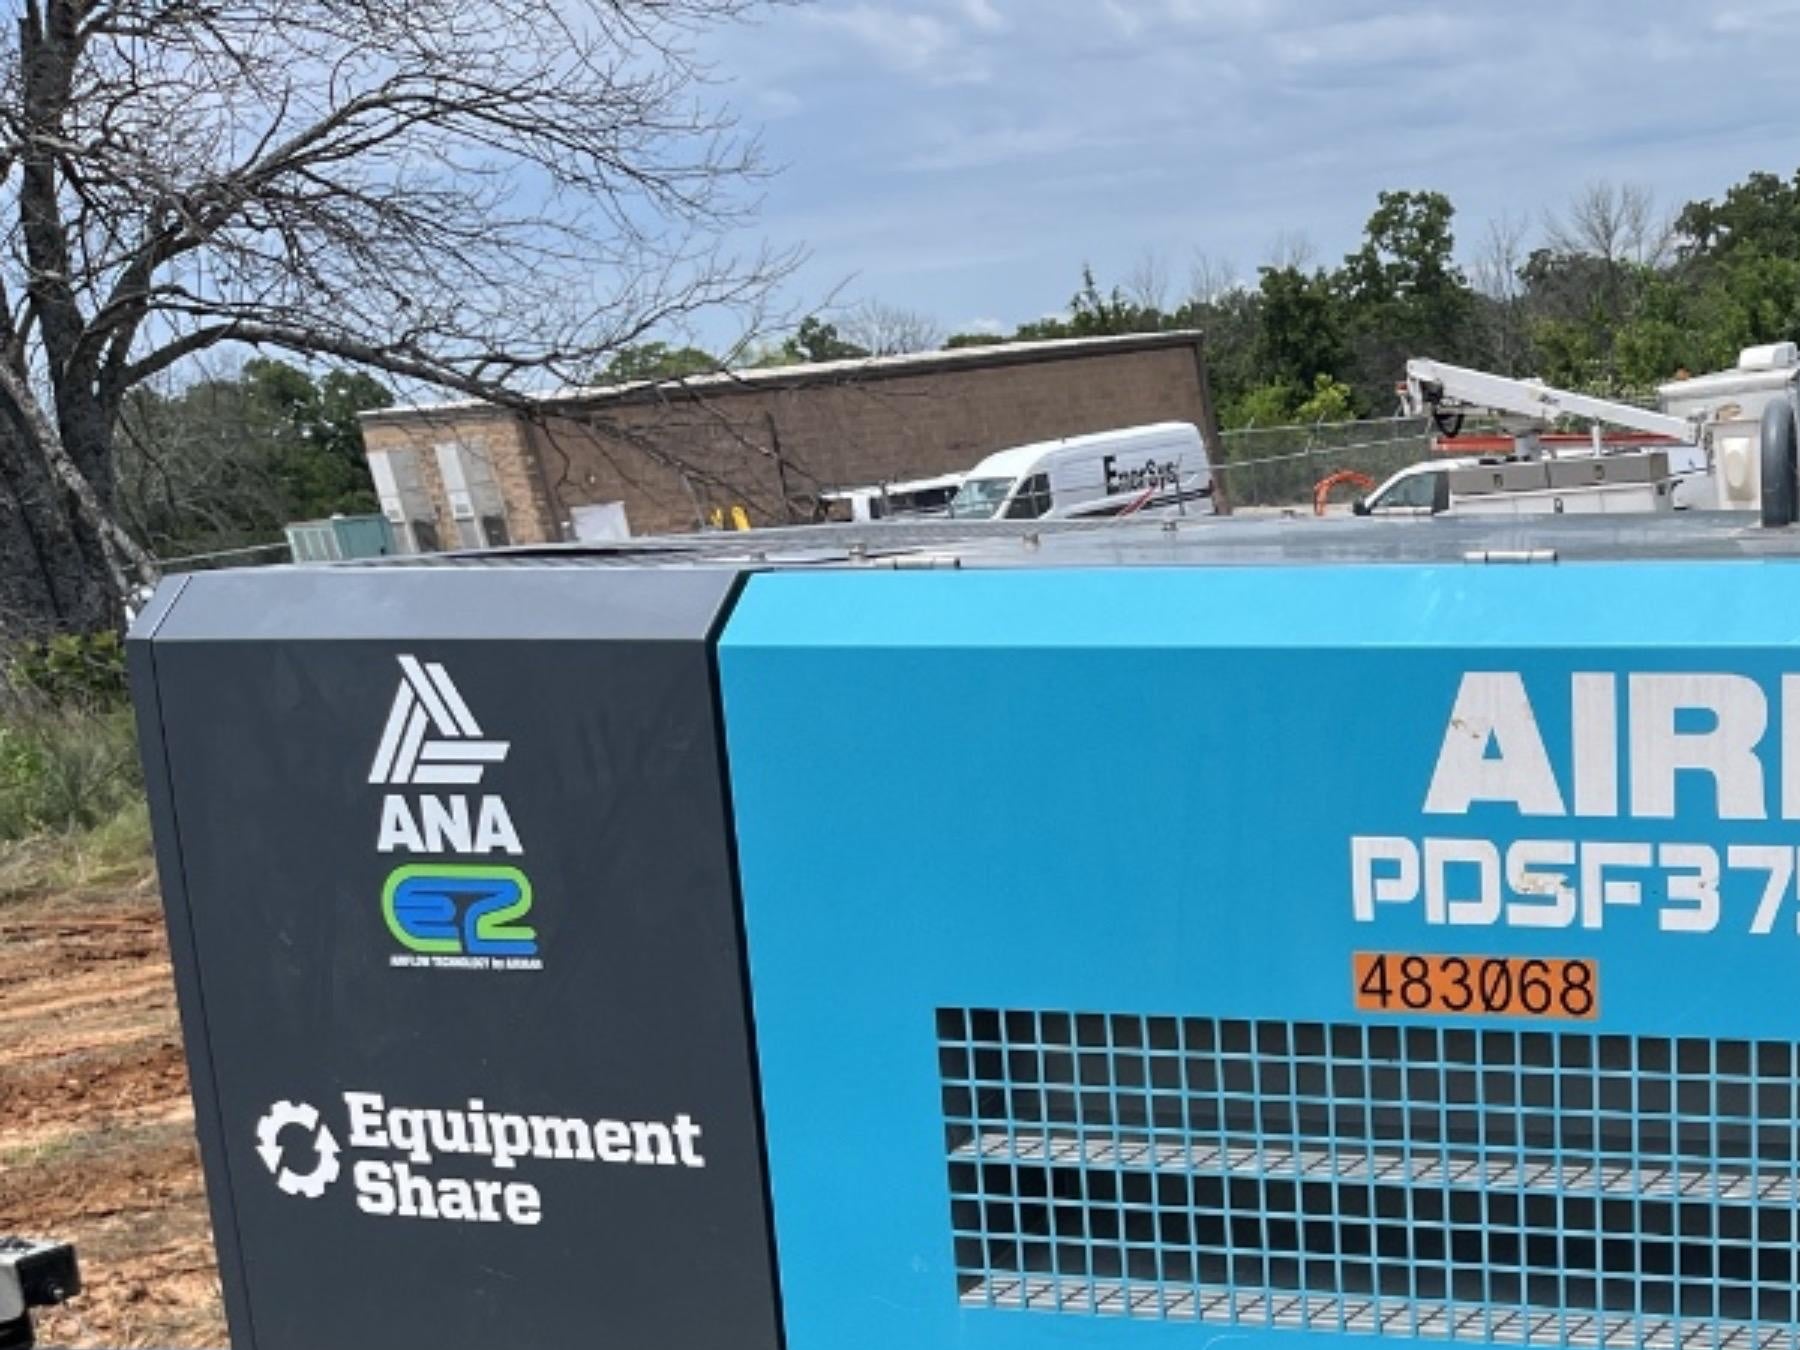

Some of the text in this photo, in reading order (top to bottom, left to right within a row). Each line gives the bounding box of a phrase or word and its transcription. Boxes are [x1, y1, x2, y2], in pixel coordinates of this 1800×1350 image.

[377, 794, 524, 854] ANA
[1360, 954, 1594, 1016] 483068
[342, 1091, 705, 1168] Equipment
[353, 1160, 543, 1225] Share
